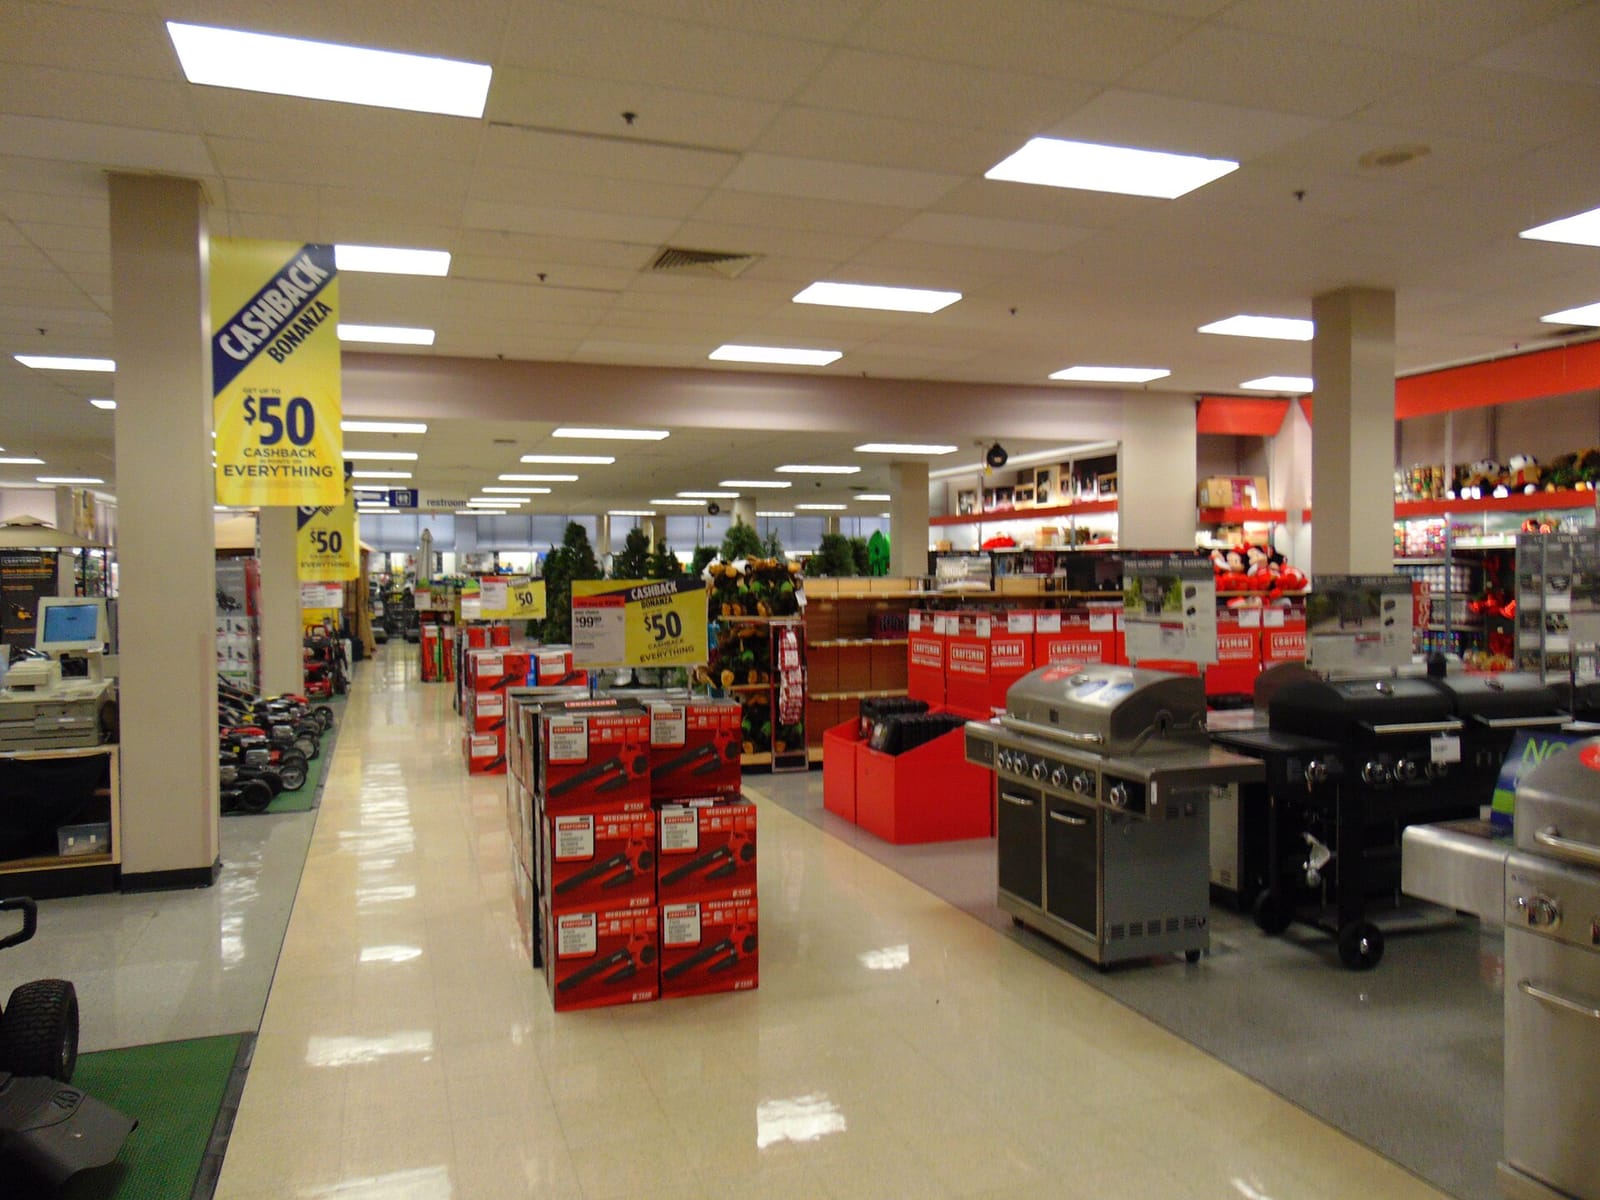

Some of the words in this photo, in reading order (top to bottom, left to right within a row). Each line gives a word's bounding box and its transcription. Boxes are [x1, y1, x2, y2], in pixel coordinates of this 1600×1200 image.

[218, 253, 329, 362] CASHBACK
[266, 300, 333, 364] BONANZA
[243, 395, 315, 446] $50
[243, 448, 317, 458] CASHBACK
[309, 531, 342, 553] $50
[630, 580, 678, 601] CASHBACK
[640, 596, 673, 609] BONANZA
[643, 610, 682, 642] $50
[639, 645, 695, 663] EVERYTHING
[1051, 645, 1099, 655] CRAFTSMAN
